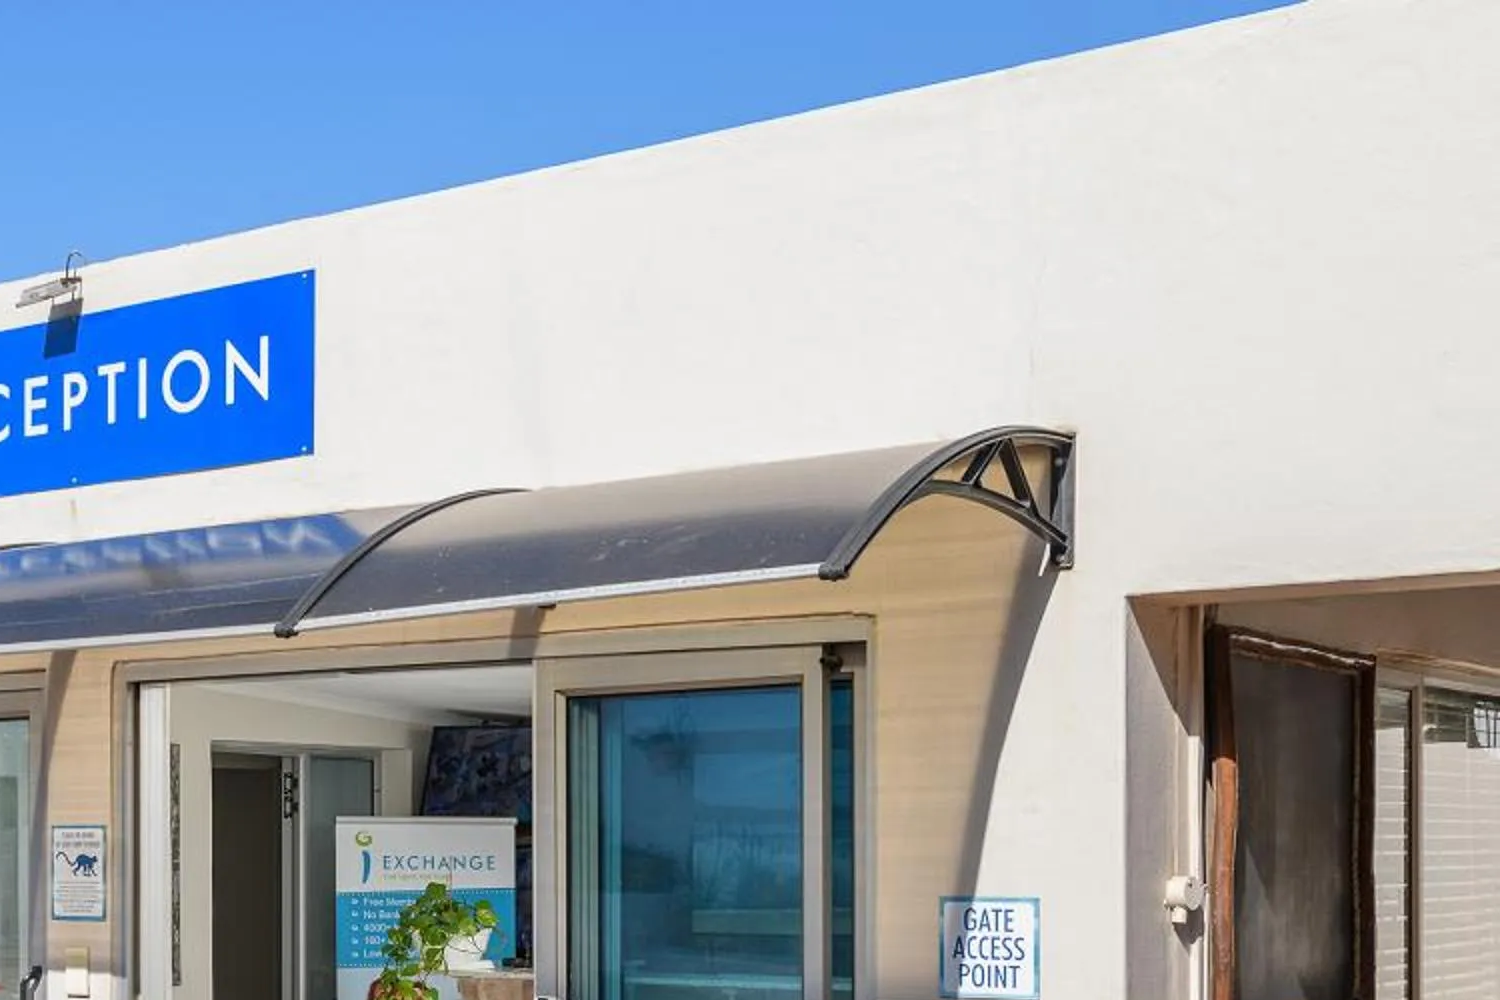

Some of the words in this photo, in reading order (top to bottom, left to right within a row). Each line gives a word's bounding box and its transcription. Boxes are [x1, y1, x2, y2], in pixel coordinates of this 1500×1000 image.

[383, 856, 497, 871] EXCHANGE
[363, 898, 384, 906] Free
[363, 910, 377, 919] No
[963, 907, 1015, 932] GATE
[952, 935, 1025, 960] ACCESS
[959, 963, 1020, 988] POINT
